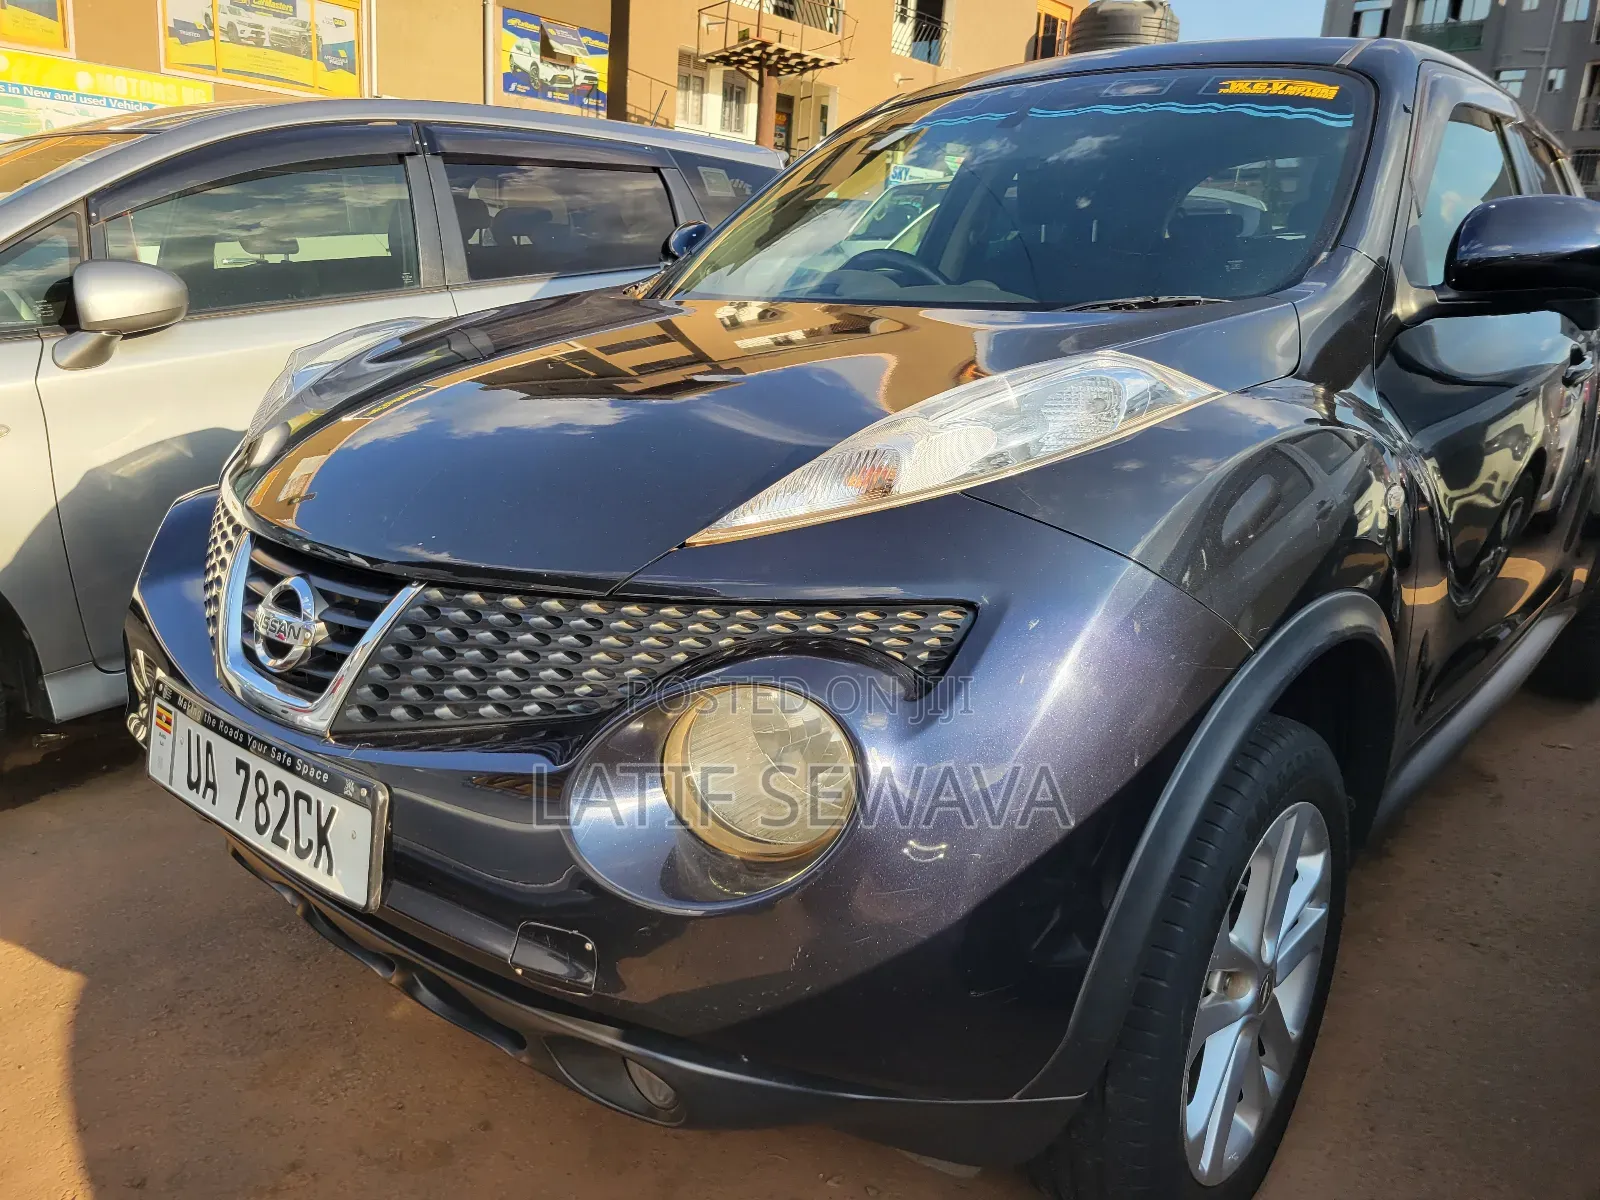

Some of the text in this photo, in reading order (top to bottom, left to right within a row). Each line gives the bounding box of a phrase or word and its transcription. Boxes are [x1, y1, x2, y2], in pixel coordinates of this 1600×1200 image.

[8, 84, 20, 94] in
[23, 86, 51, 98] New
[54, 92, 77, 102] and
[80, 96, 107, 106] used
[177, 695, 329, 783] Making the Roads Your Safe Space
[186, 728, 338, 877] UA 782CK
